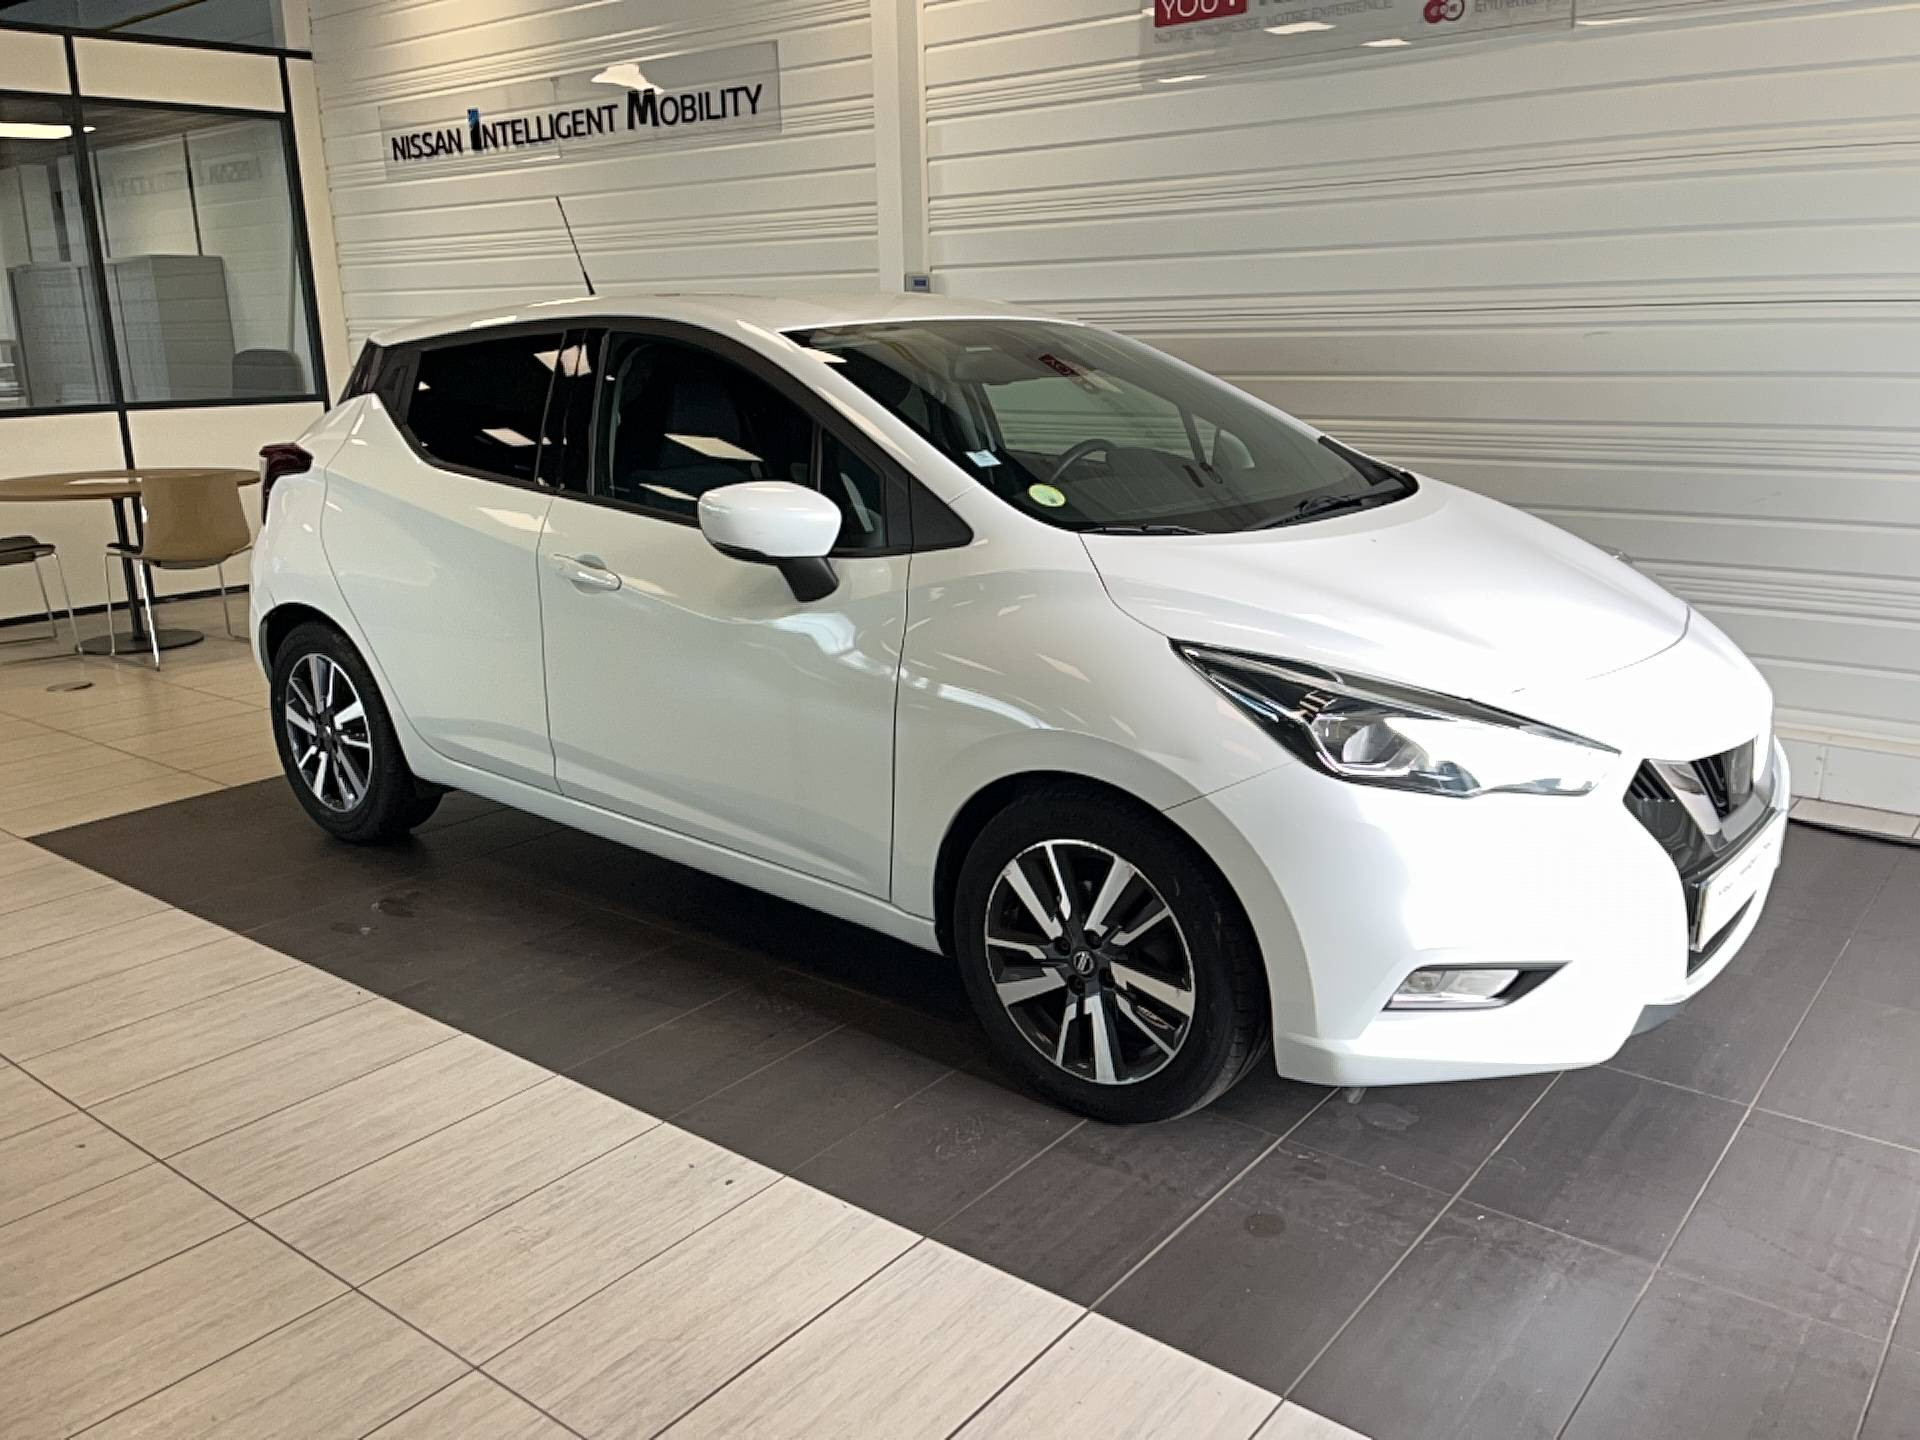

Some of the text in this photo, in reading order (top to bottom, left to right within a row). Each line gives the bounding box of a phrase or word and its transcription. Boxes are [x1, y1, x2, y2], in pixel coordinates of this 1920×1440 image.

[391, 83, 762, 161] NISSAN INTELLIGENT MOBILITY
